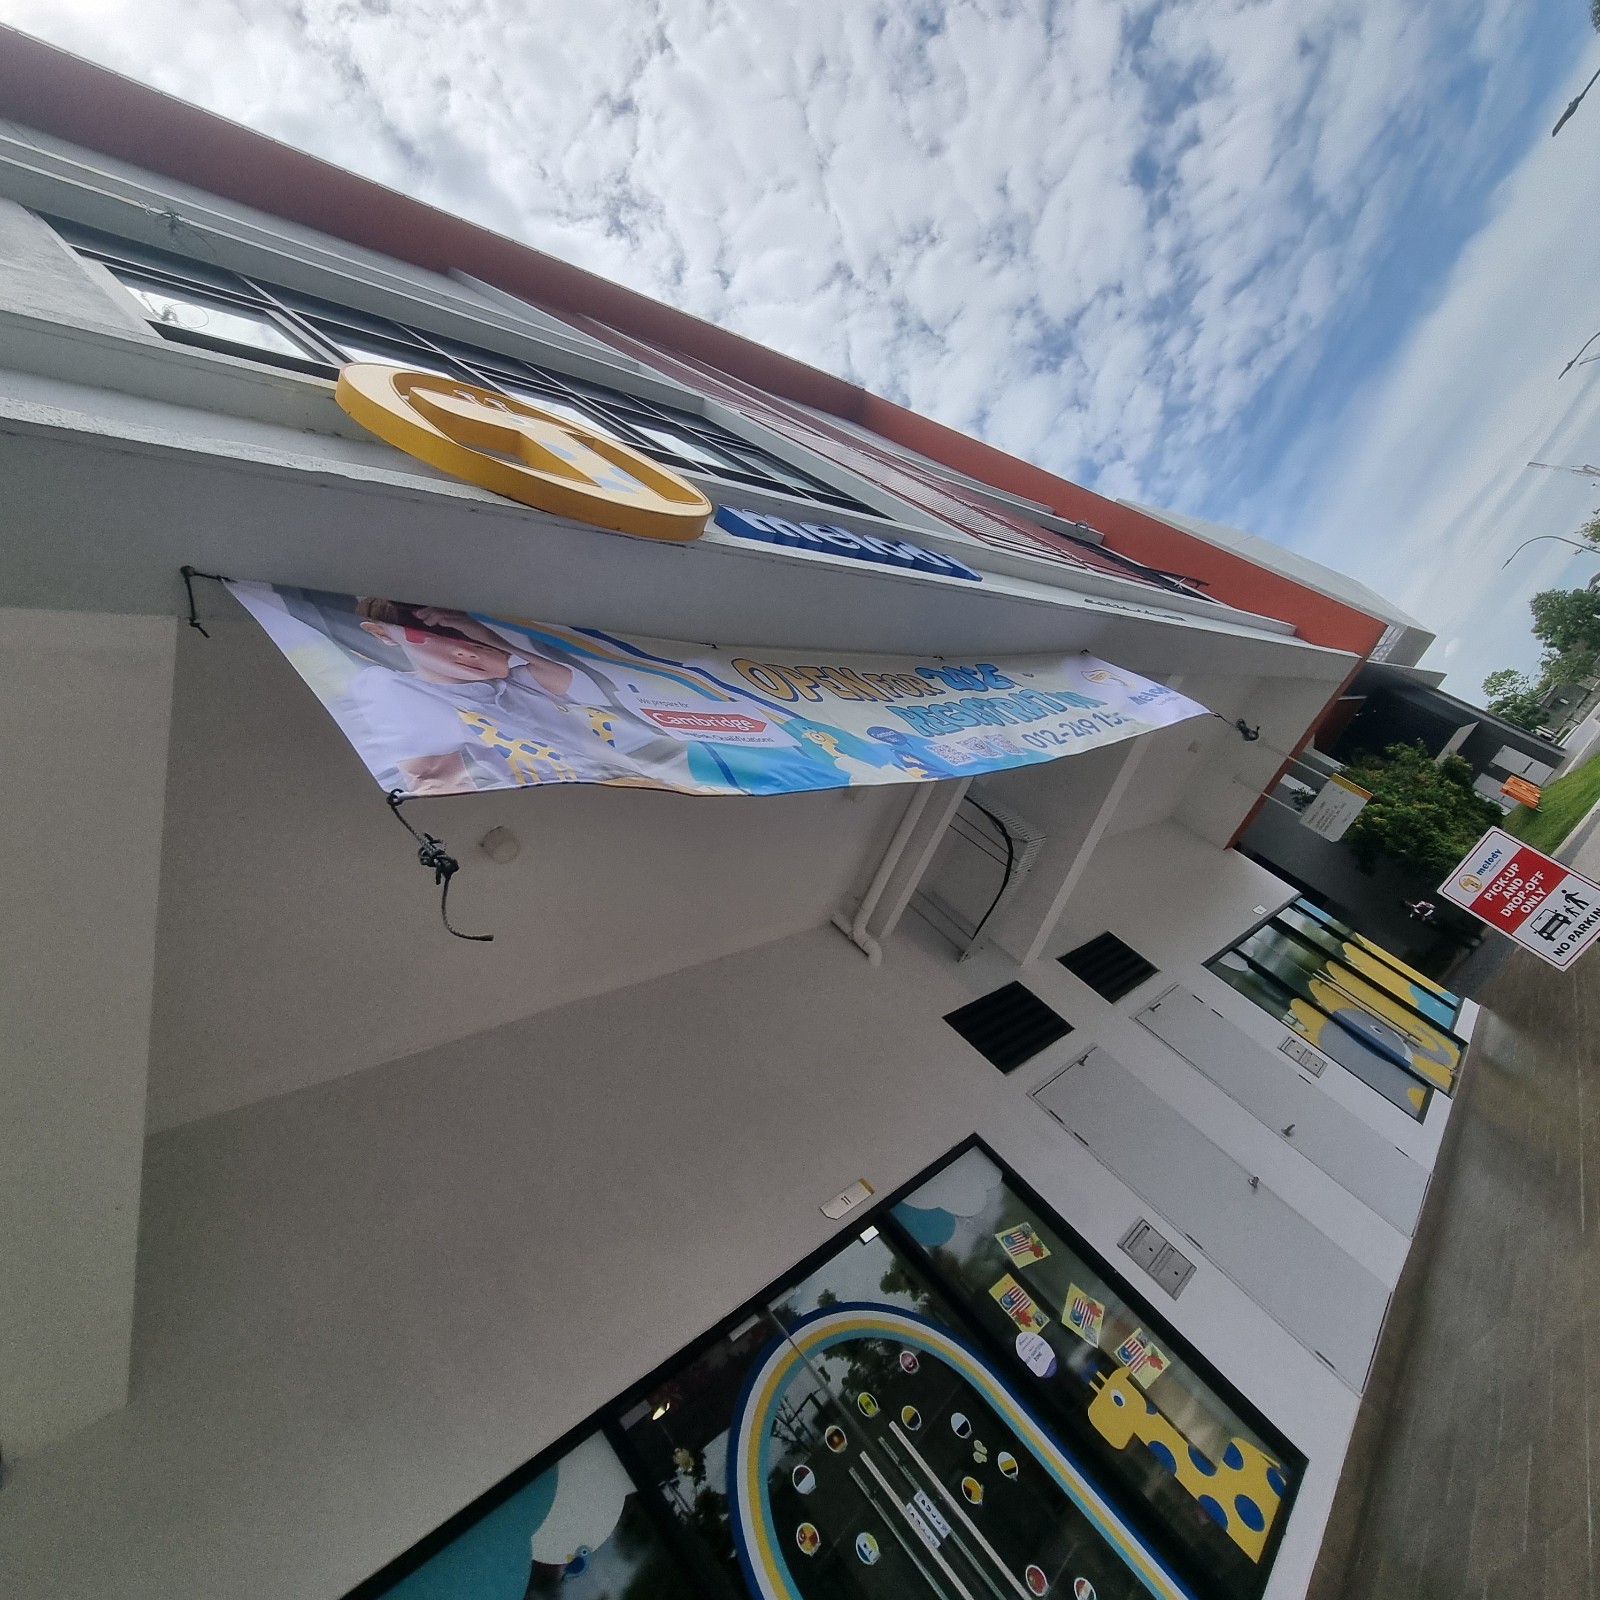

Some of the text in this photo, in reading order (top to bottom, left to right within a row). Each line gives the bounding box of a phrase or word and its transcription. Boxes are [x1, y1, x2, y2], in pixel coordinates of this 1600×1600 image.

[731, 657, 895, 703] OPEN
[862, 673, 946, 699] FOR
[651, 699, 678, 708] prepare
[652, 712, 755, 732] Cambridge
[1476, 848, 1503, 876] melody
[1483, 863, 1520, 902] PICK-UP
[1500, 870, 1545, 918] DROP-OFF
[1502, 878, 1524, 900] AND
[1520, 887, 1547, 914] ONLY
[1553, 904, 1600, 957] NO PARKIN
